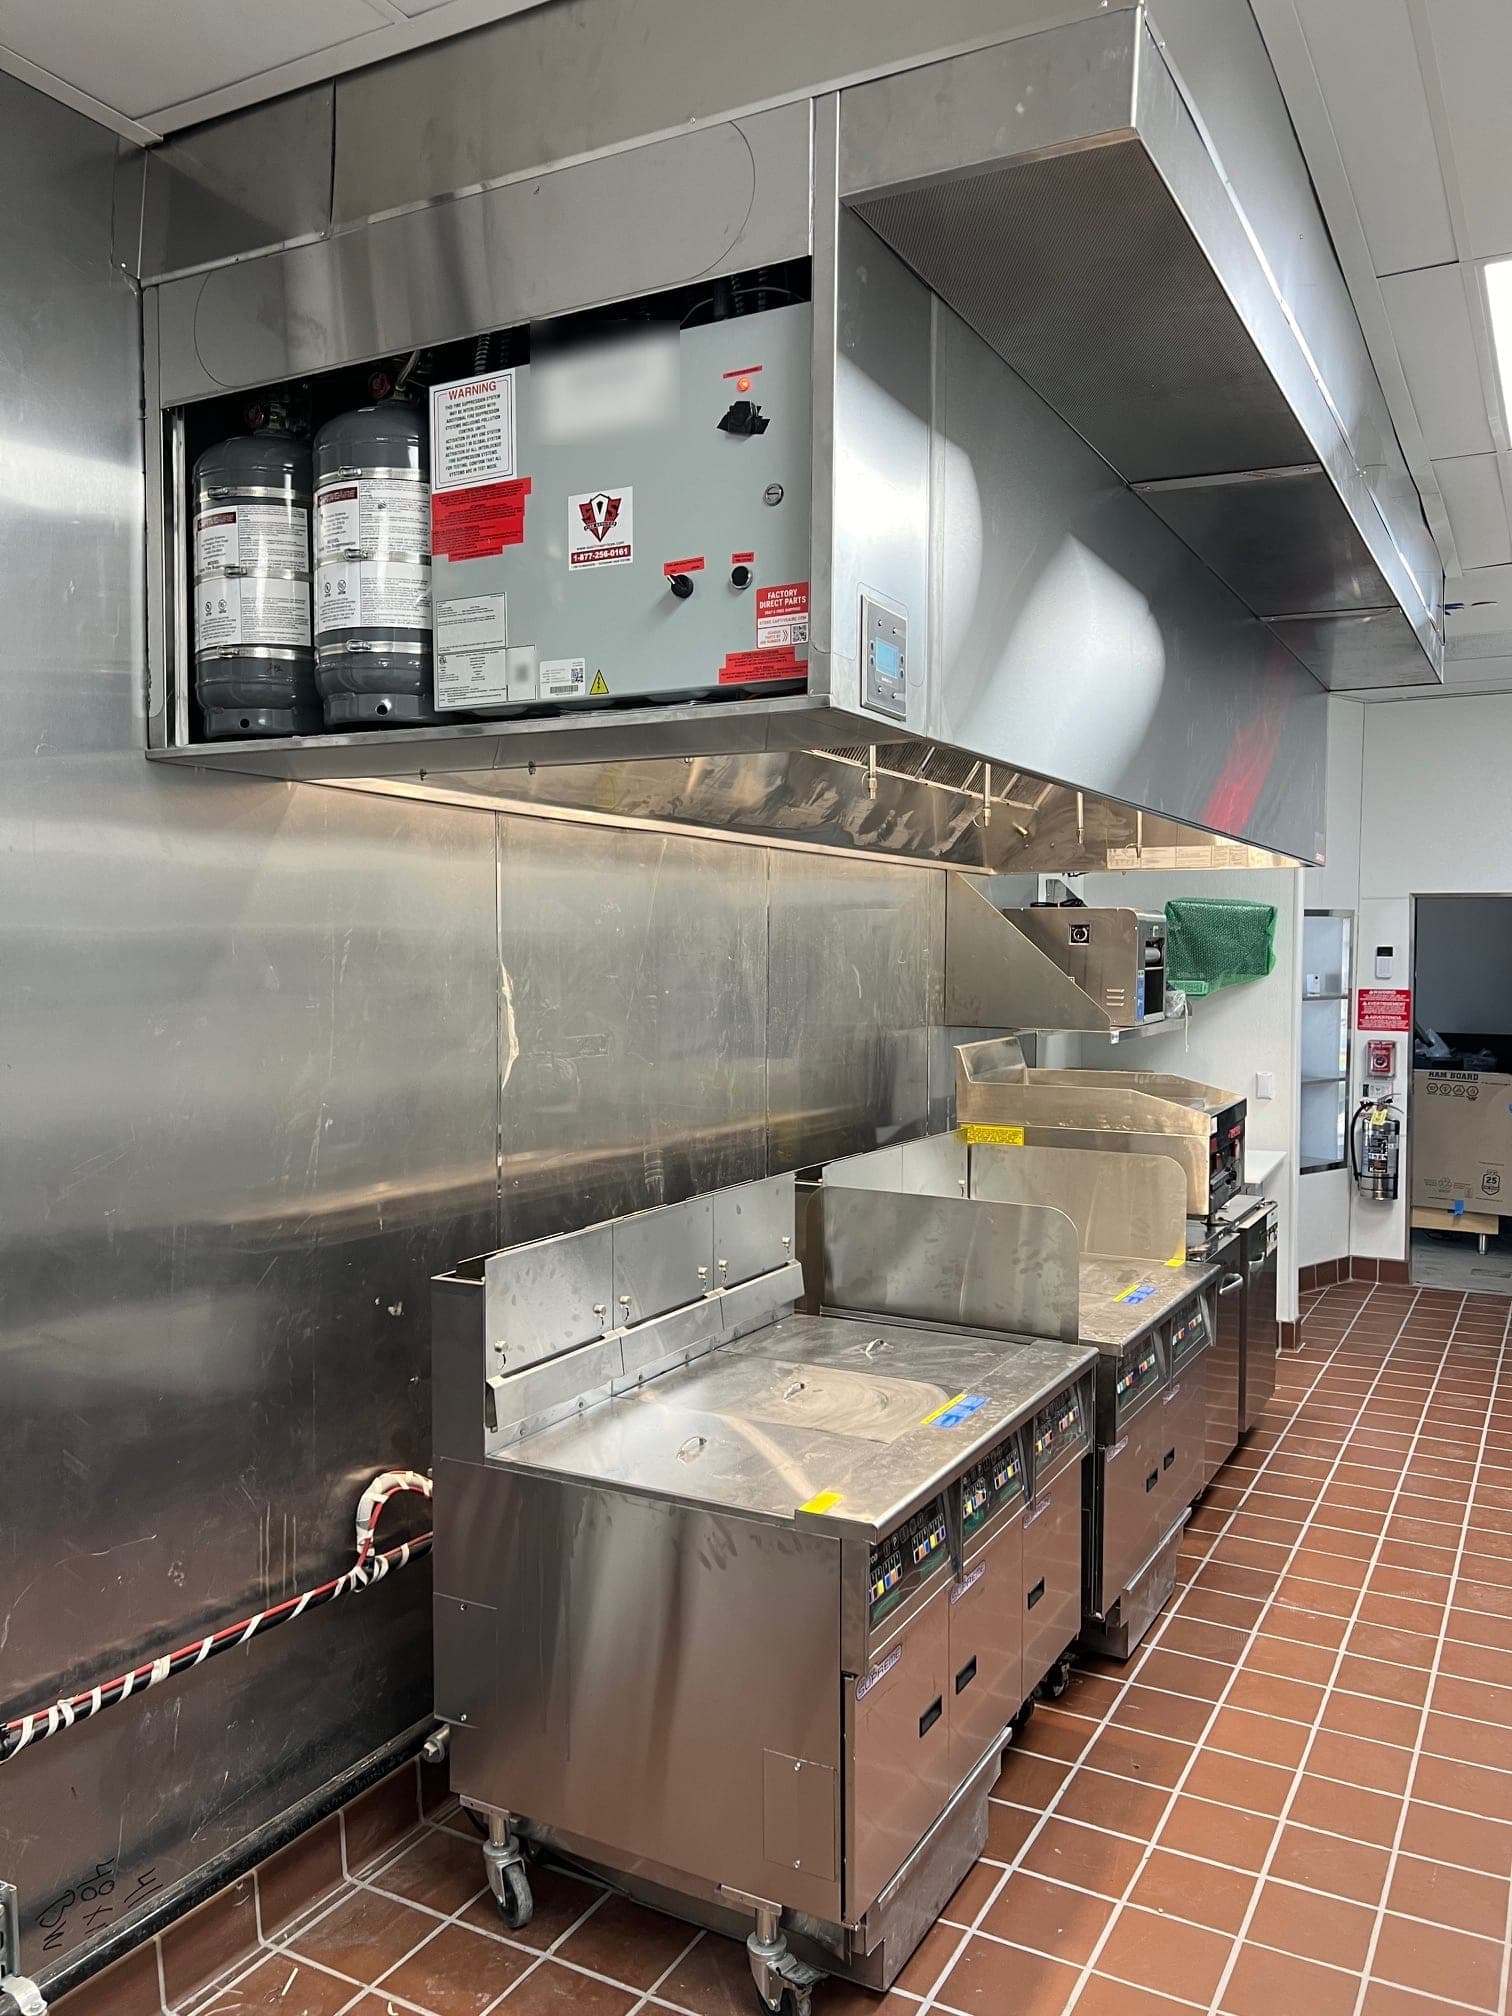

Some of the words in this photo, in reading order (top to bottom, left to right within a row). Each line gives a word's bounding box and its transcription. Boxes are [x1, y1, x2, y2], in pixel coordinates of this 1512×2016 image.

[449, 381, 496, 400] WARNING
[767, 588, 798, 600] FACTORY
[759, 599, 784, 609] DIRECT
[784, 596, 807, 606] PARTS
[1449, 1072, 1479, 1081] BOARD
[1486, 1176, 1498, 1184] 25
[857, 1647, 901, 1698] SUPREME
